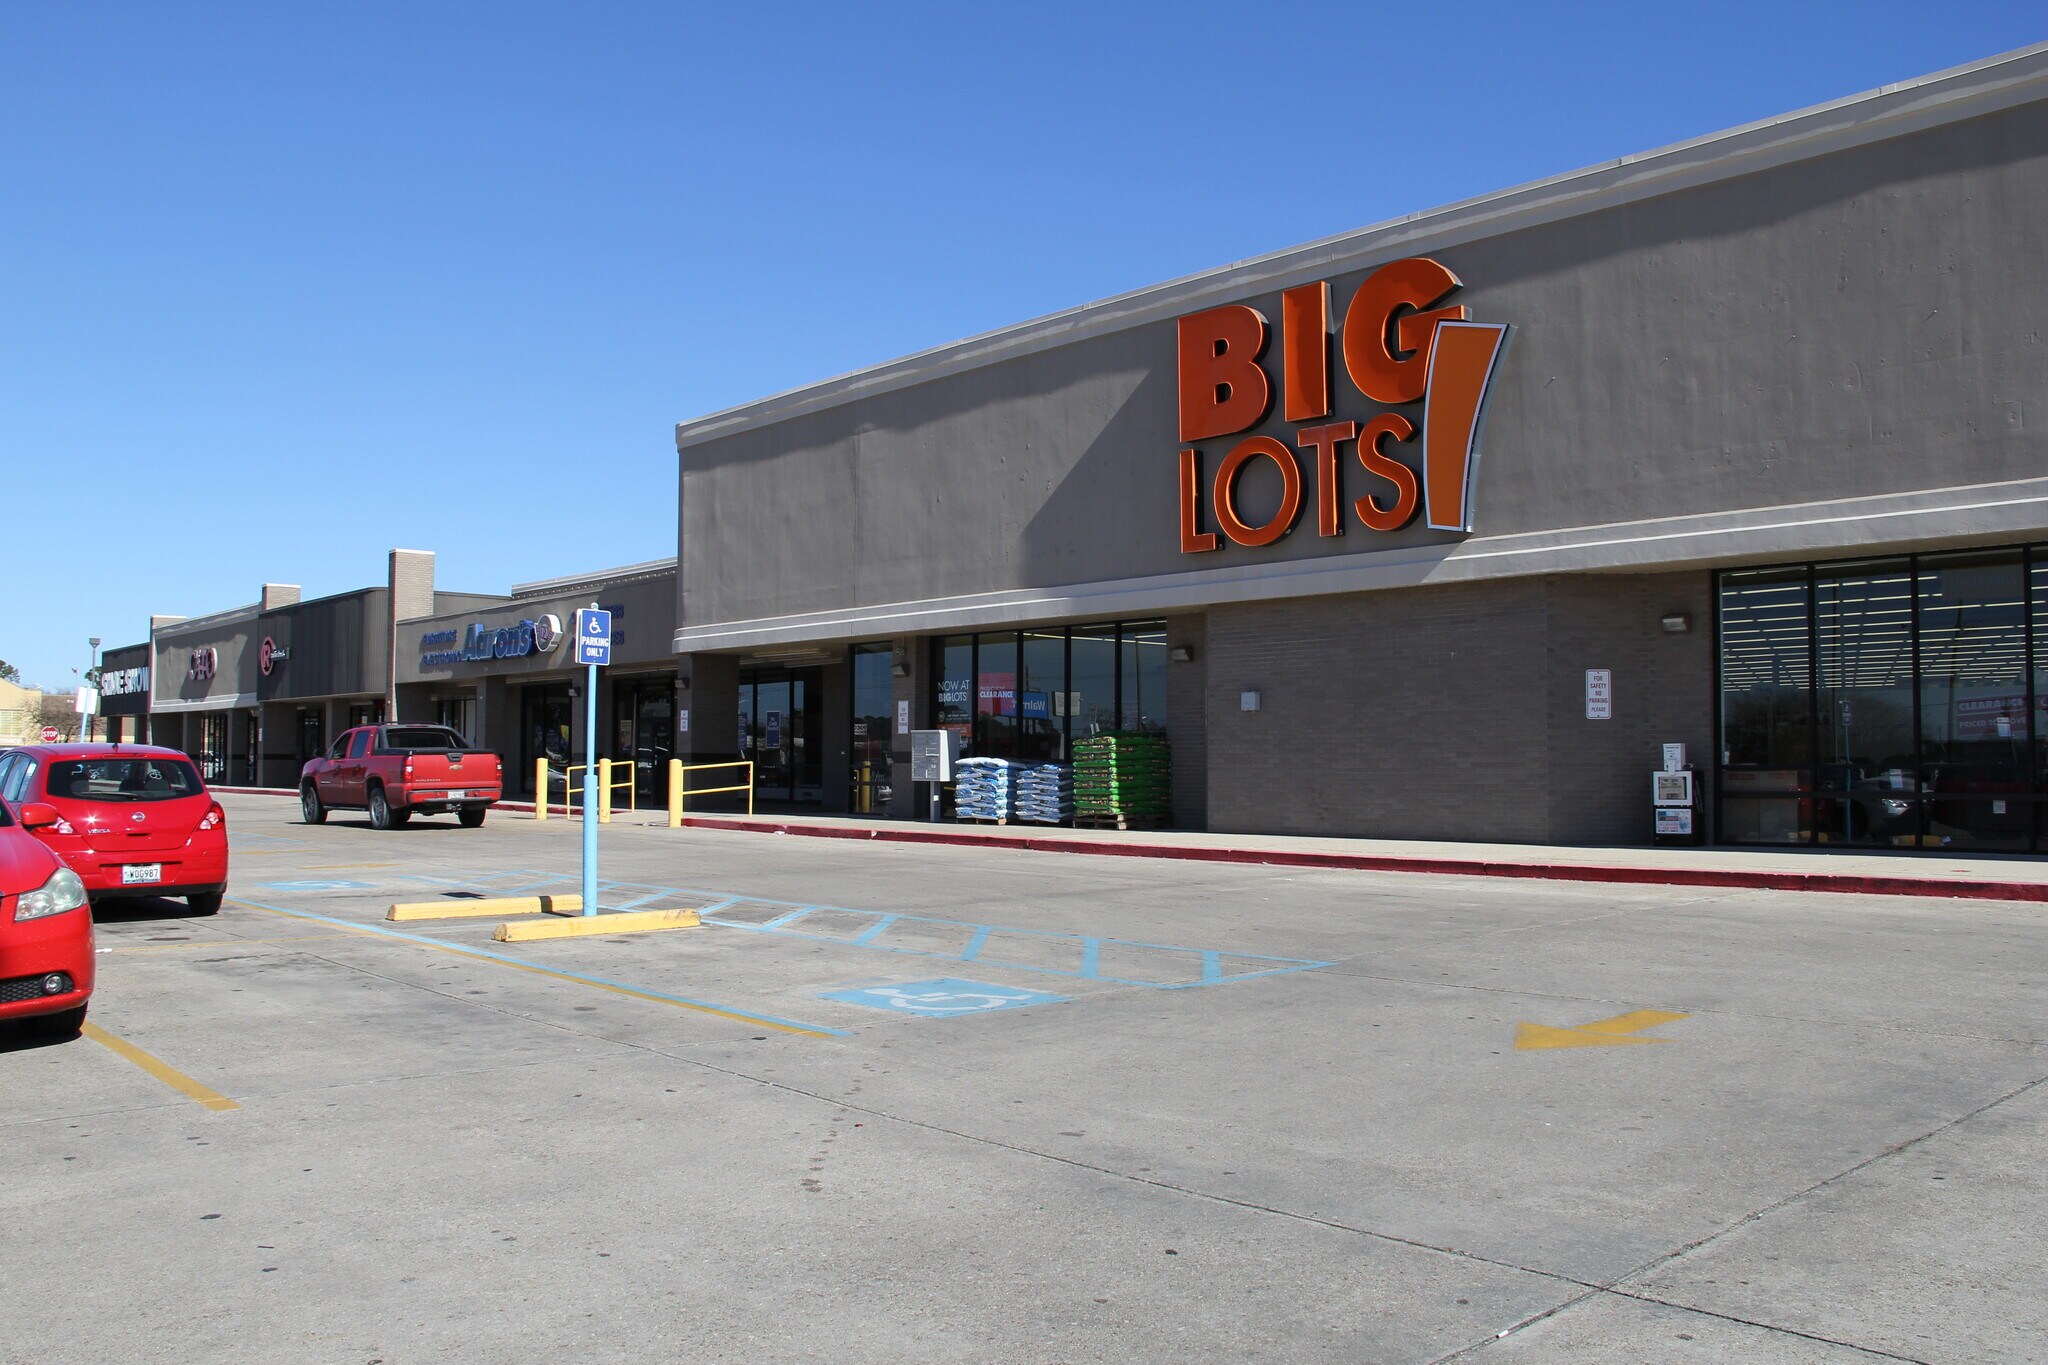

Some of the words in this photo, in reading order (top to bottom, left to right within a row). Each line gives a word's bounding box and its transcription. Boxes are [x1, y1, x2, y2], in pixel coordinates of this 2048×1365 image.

[1177, 257, 1472, 443] BIG
[461, 621, 532, 661] Aaron's
[581, 636, 609, 647] PARKING
[586, 647, 604, 657] ONLY
[938, 680, 959, 692] NOW
[960, 679, 970, 690] AT
[979, 690, 1013, 698] CLEARANCE
[1959, 720, 1987, 729] PRICED
